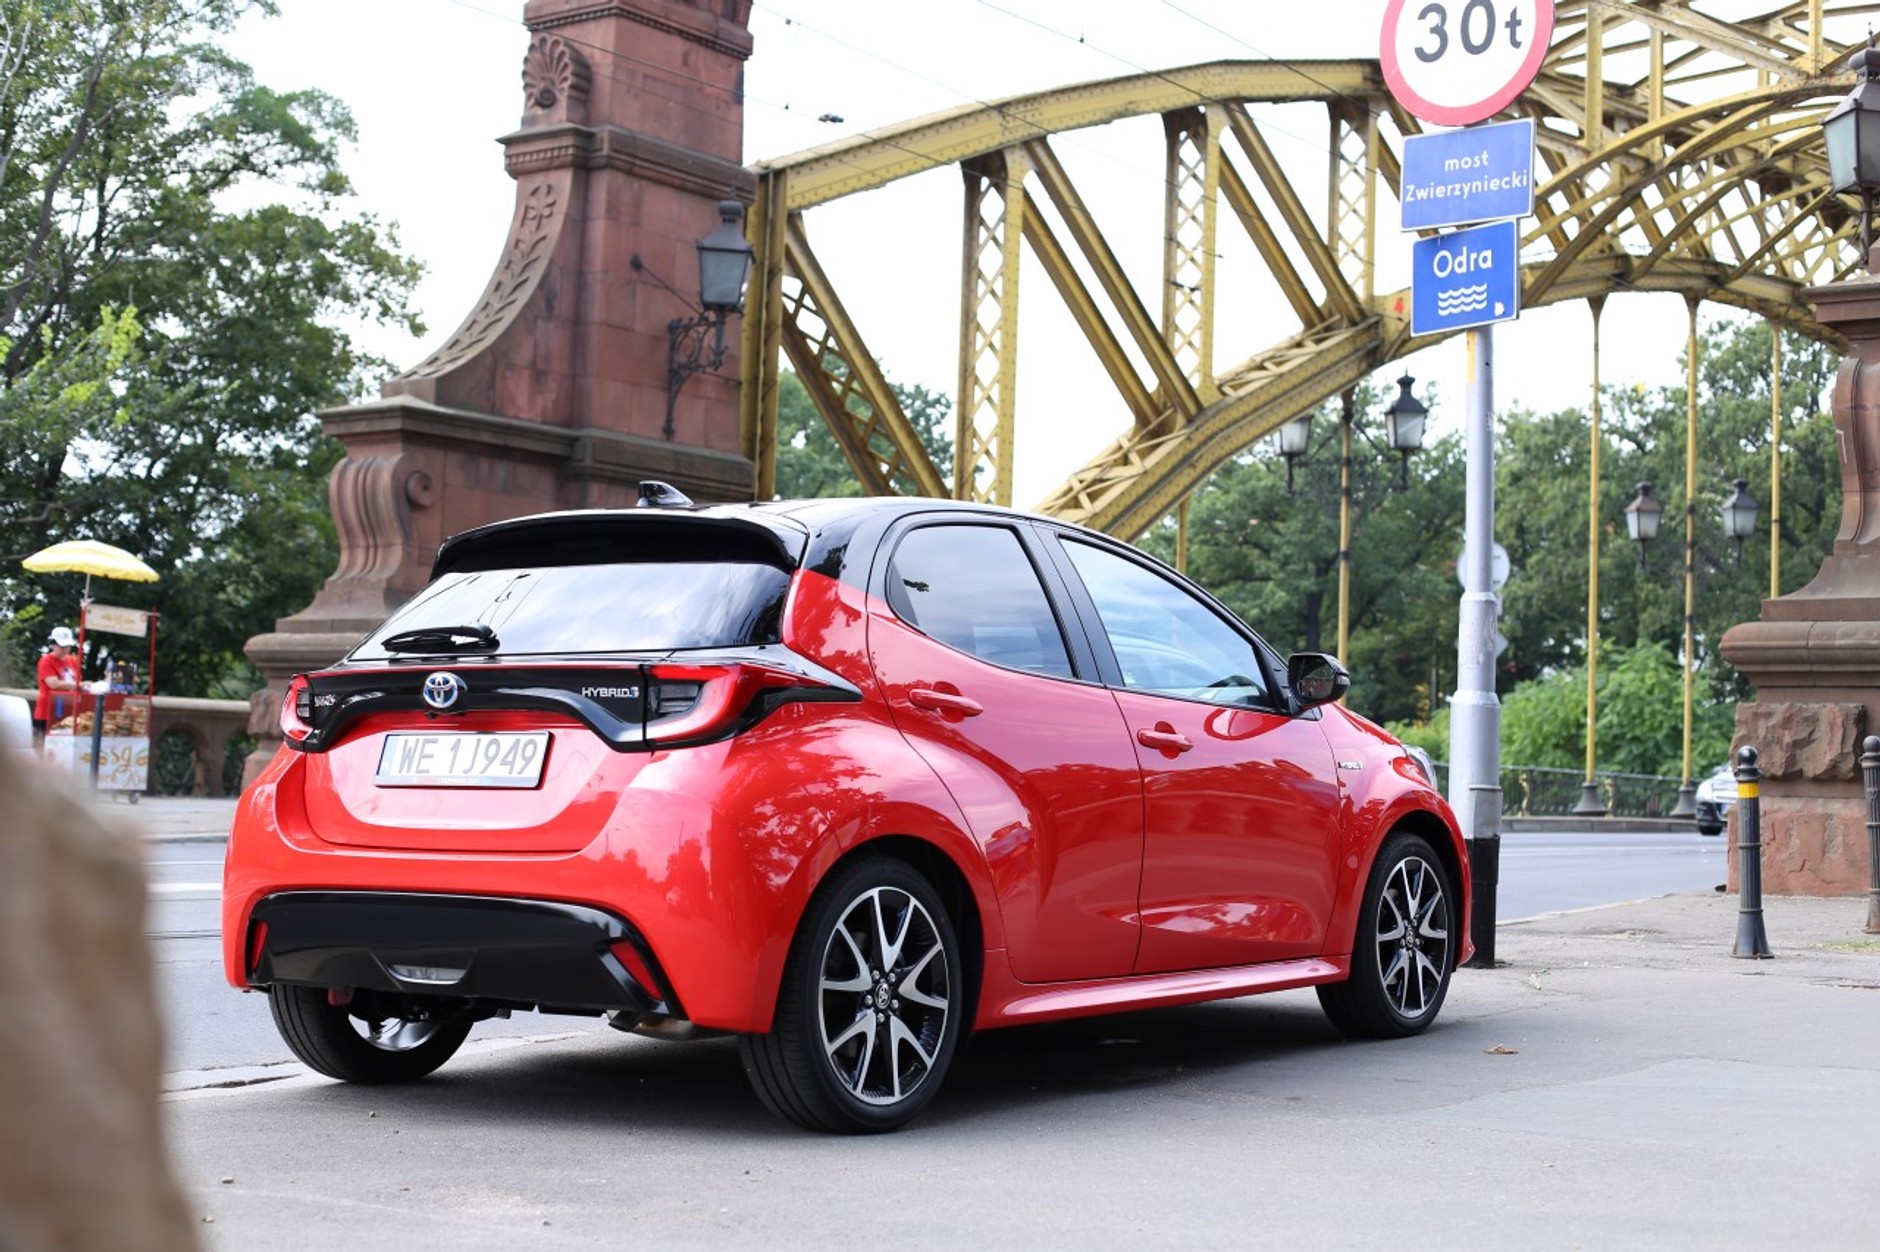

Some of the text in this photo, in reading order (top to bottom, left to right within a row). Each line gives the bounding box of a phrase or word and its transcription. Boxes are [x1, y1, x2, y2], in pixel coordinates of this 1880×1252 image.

[1444, 150, 1490, 172] most
[1405, 169, 1528, 203] Zwierzyniecki
[1432, 246, 1493, 279] Odra
[581, 686, 630, 698] HYBRID
[398, 738, 538, 775] WE 1J949
